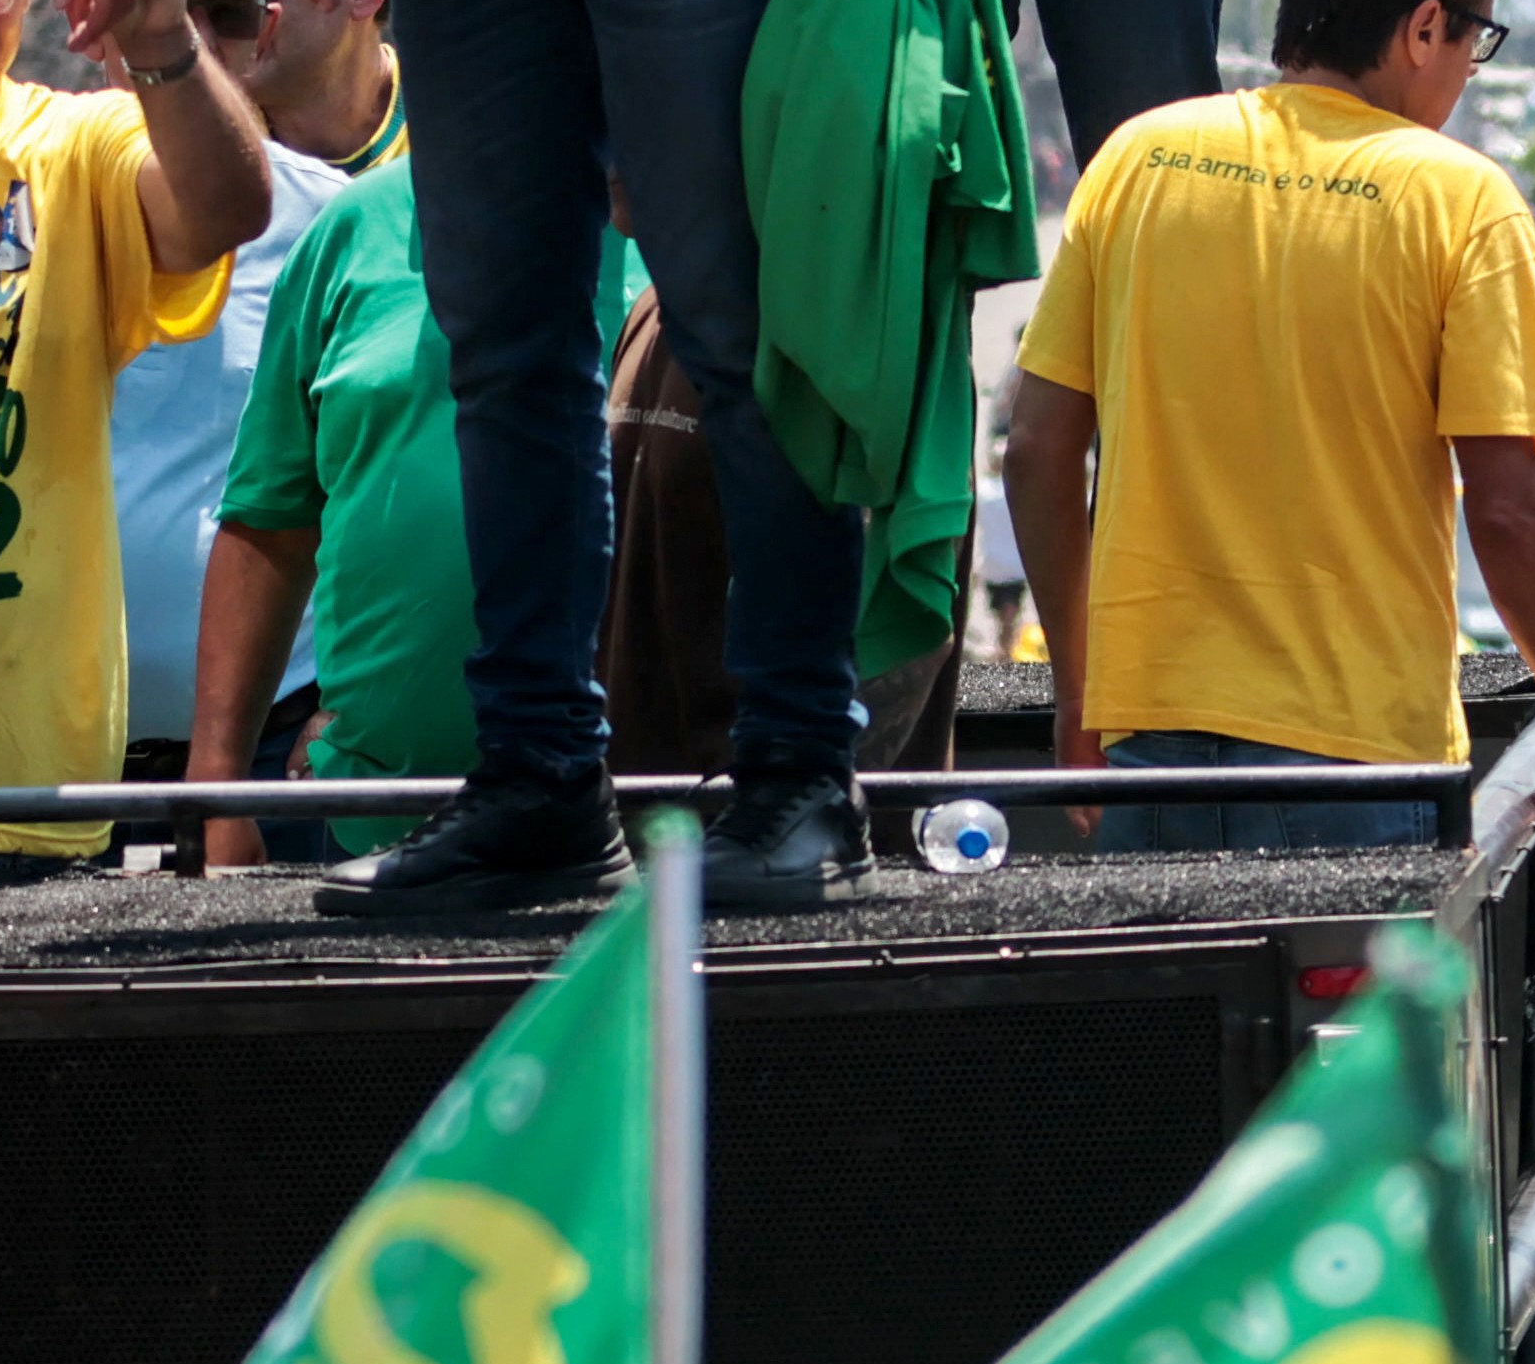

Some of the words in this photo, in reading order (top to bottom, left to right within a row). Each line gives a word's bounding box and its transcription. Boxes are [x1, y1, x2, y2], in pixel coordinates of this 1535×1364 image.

[1147, 146, 1191, 171] Sua
[1195, 156, 1266, 187] arma
[1274, 169, 1291, 190] é
[1298, 175, 1313, 190] o
[1323, 176, 1384, 205] voto.
